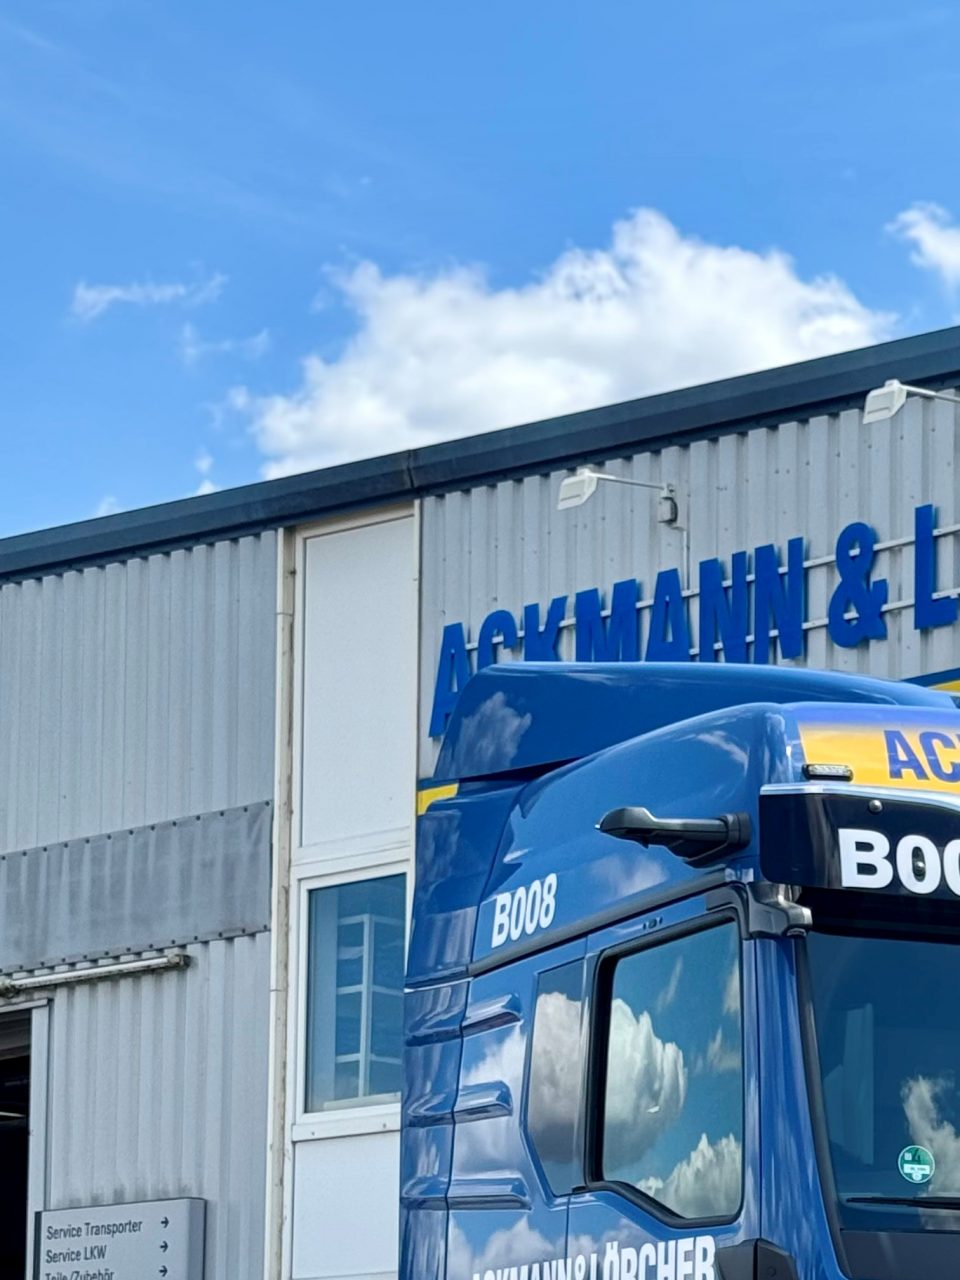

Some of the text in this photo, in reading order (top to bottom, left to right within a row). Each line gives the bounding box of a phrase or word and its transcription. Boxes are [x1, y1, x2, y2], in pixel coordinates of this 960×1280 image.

[828, 522, 888, 649] &
[491, 872, 558, 949] B008
[45, 1244, 107, 1264] Service LKW
[46, 1219, 143, 1240] Service Transporter
